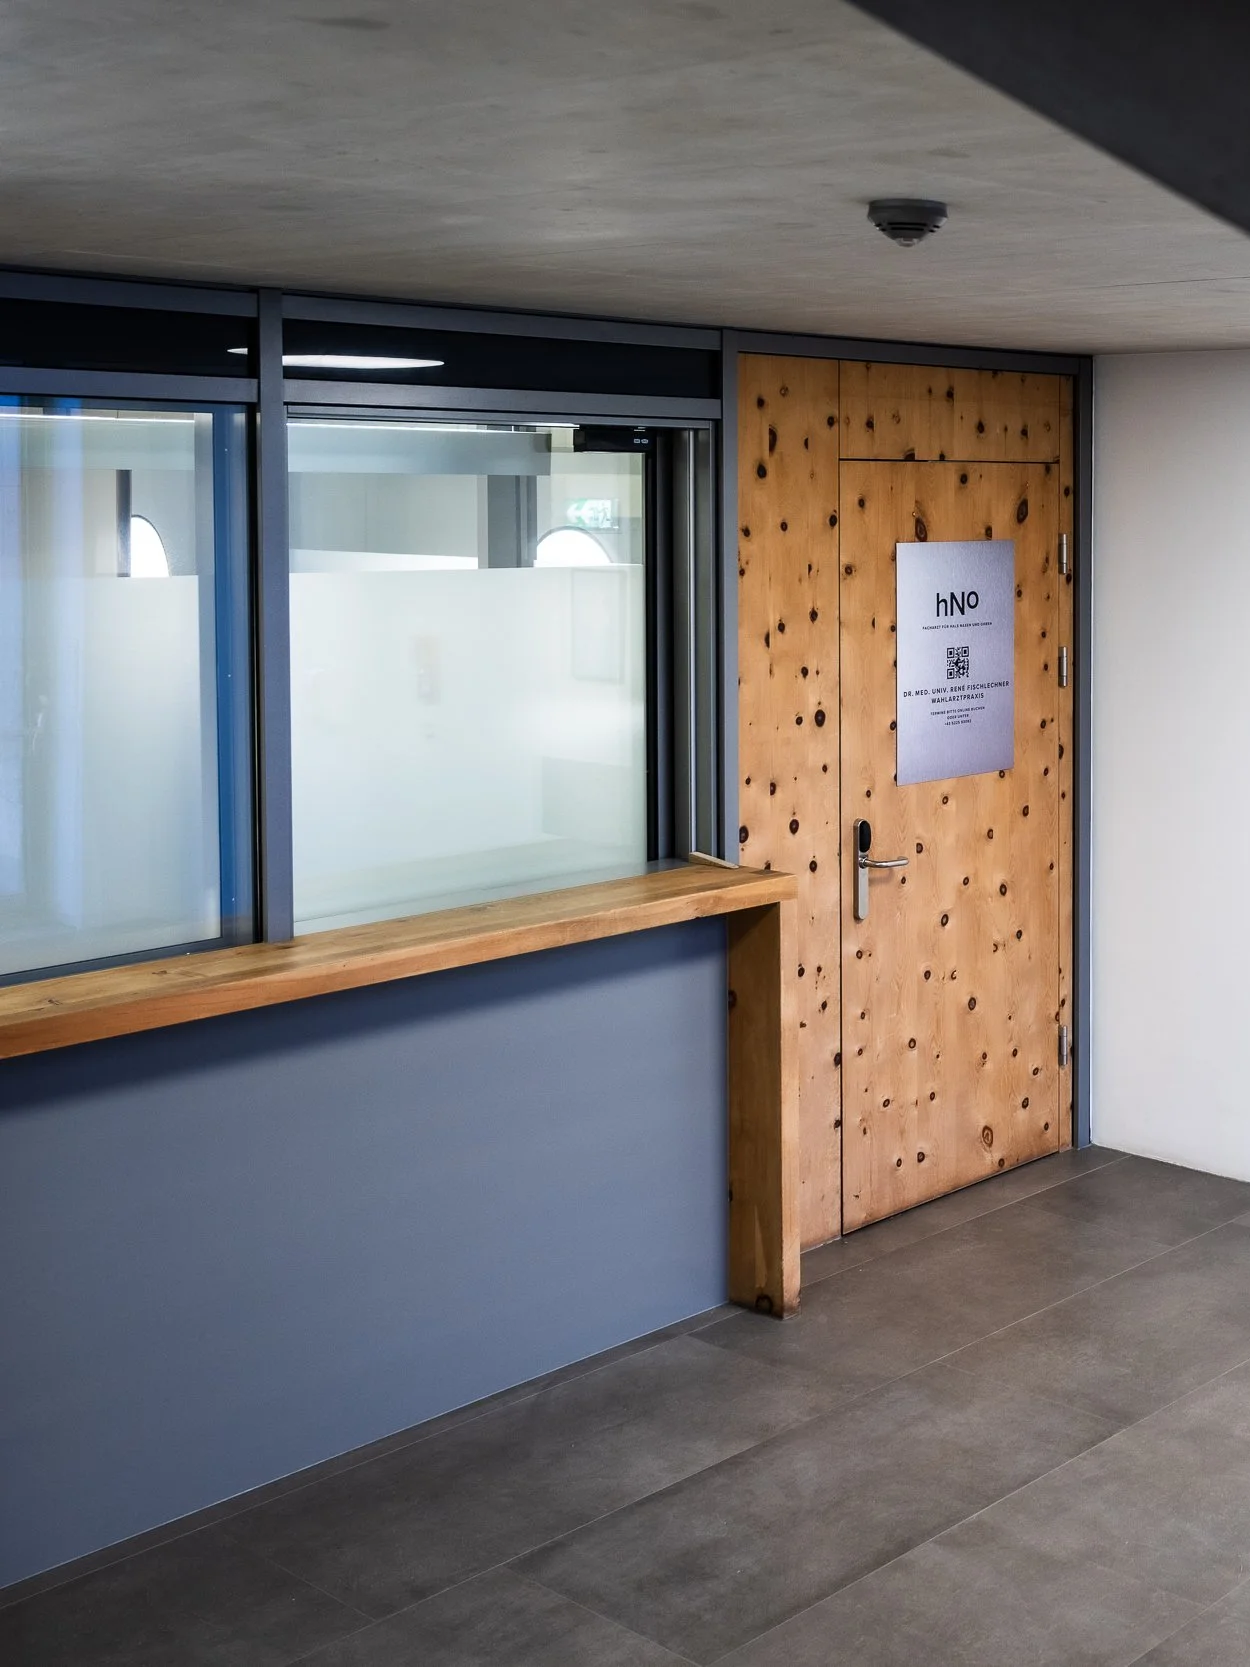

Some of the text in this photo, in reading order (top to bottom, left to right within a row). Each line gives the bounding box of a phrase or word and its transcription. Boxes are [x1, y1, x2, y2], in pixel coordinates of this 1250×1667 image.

[936, 591, 979, 617] hNo
[950, 684, 965, 692] RENÉ
[967, 681, 1009, 690] FISCHLECHNER
[931, 693, 984, 704] WAHLARZTPRAXIS
